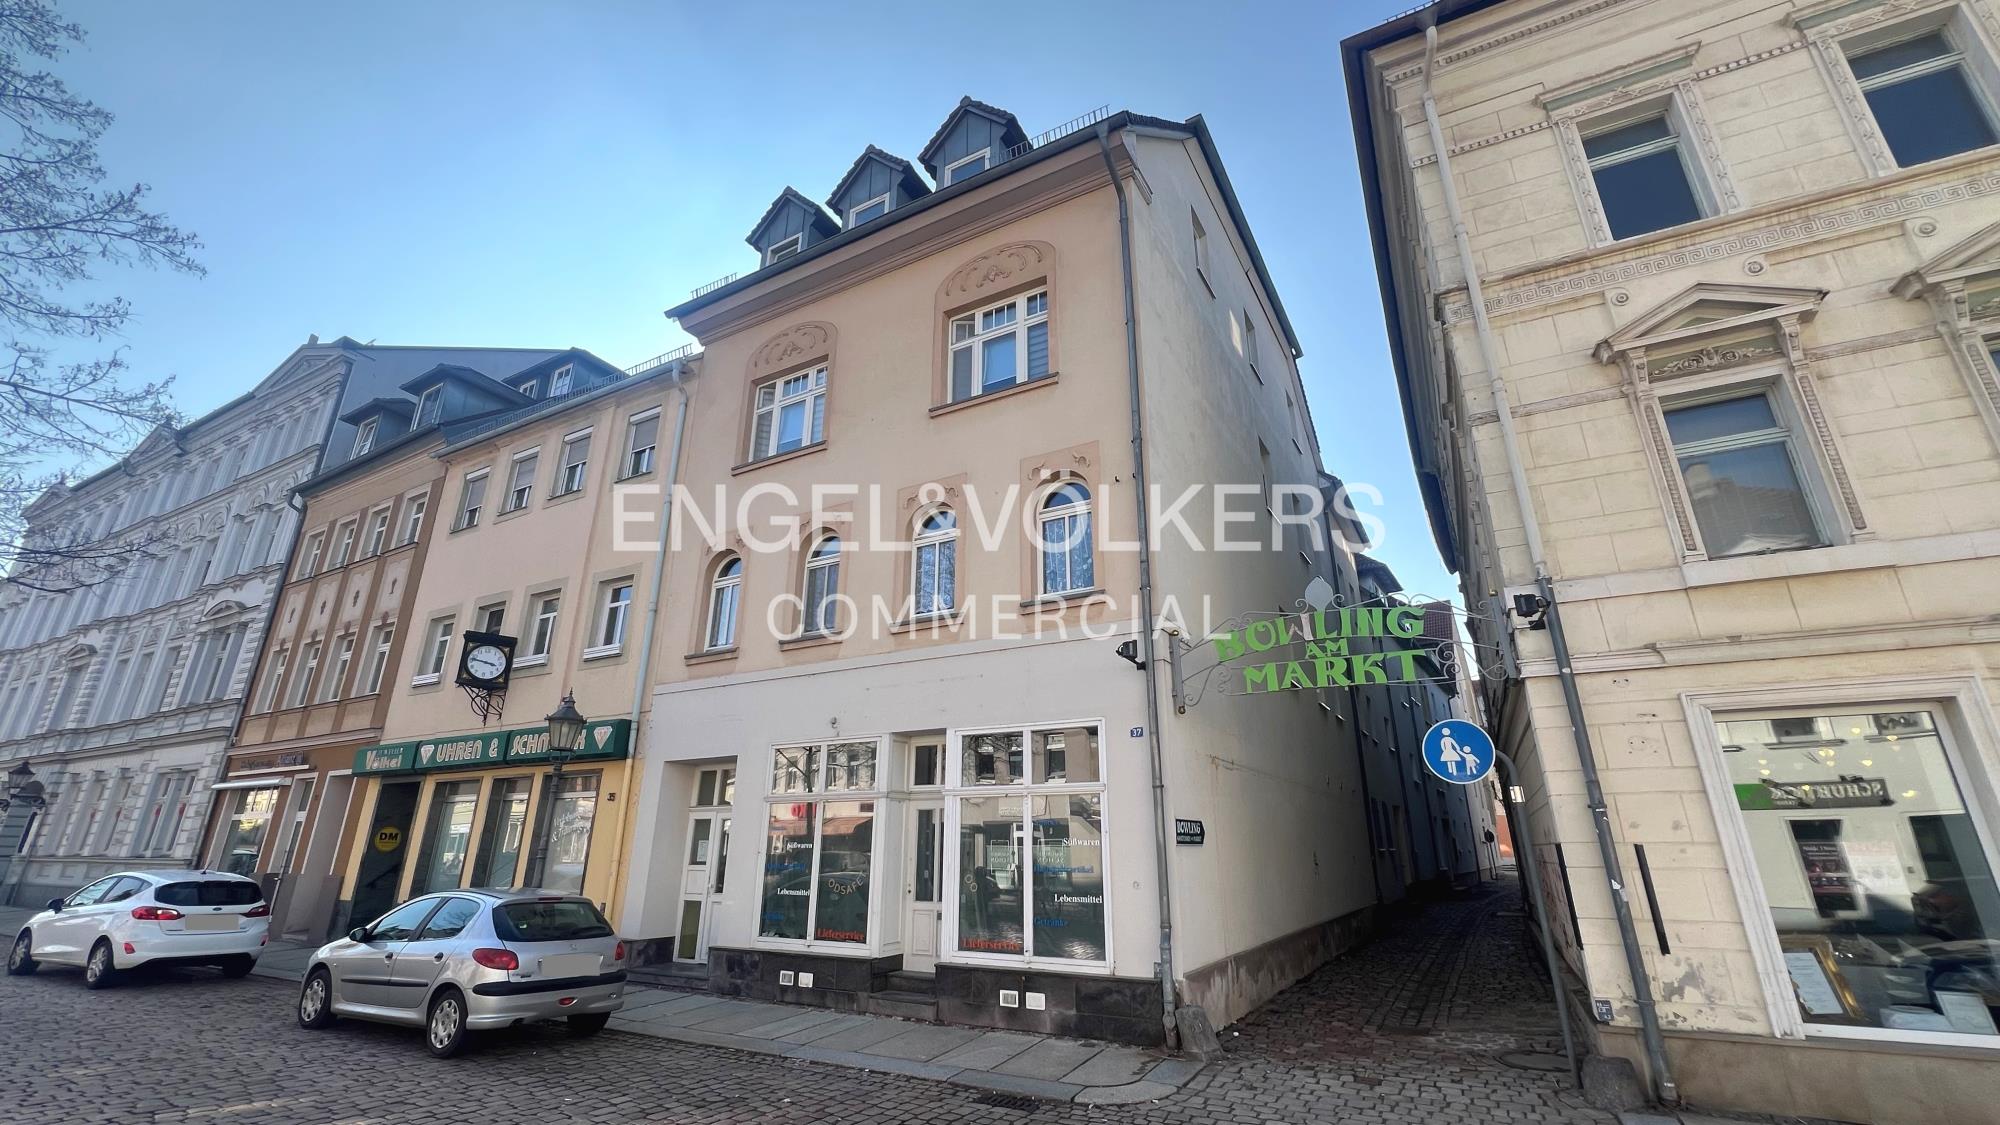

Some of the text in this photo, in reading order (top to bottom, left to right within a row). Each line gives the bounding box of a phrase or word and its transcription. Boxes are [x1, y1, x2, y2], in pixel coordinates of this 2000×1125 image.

[1214, 606, 1426, 662] BOWLING
[1305, 638, 1349, 659] AM
[1243, 650, 1427, 694] MARKT
[1132, 728, 1142, 737] 37
[436, 729, 586, 763] UHREN & SCHMK
[607, 792, 616, 802] 35
[379, 832, 400, 842] DM
[1062, 837, 1100, 846] Süßwaren
[1054, 893, 1103, 904] Lebensmittel
